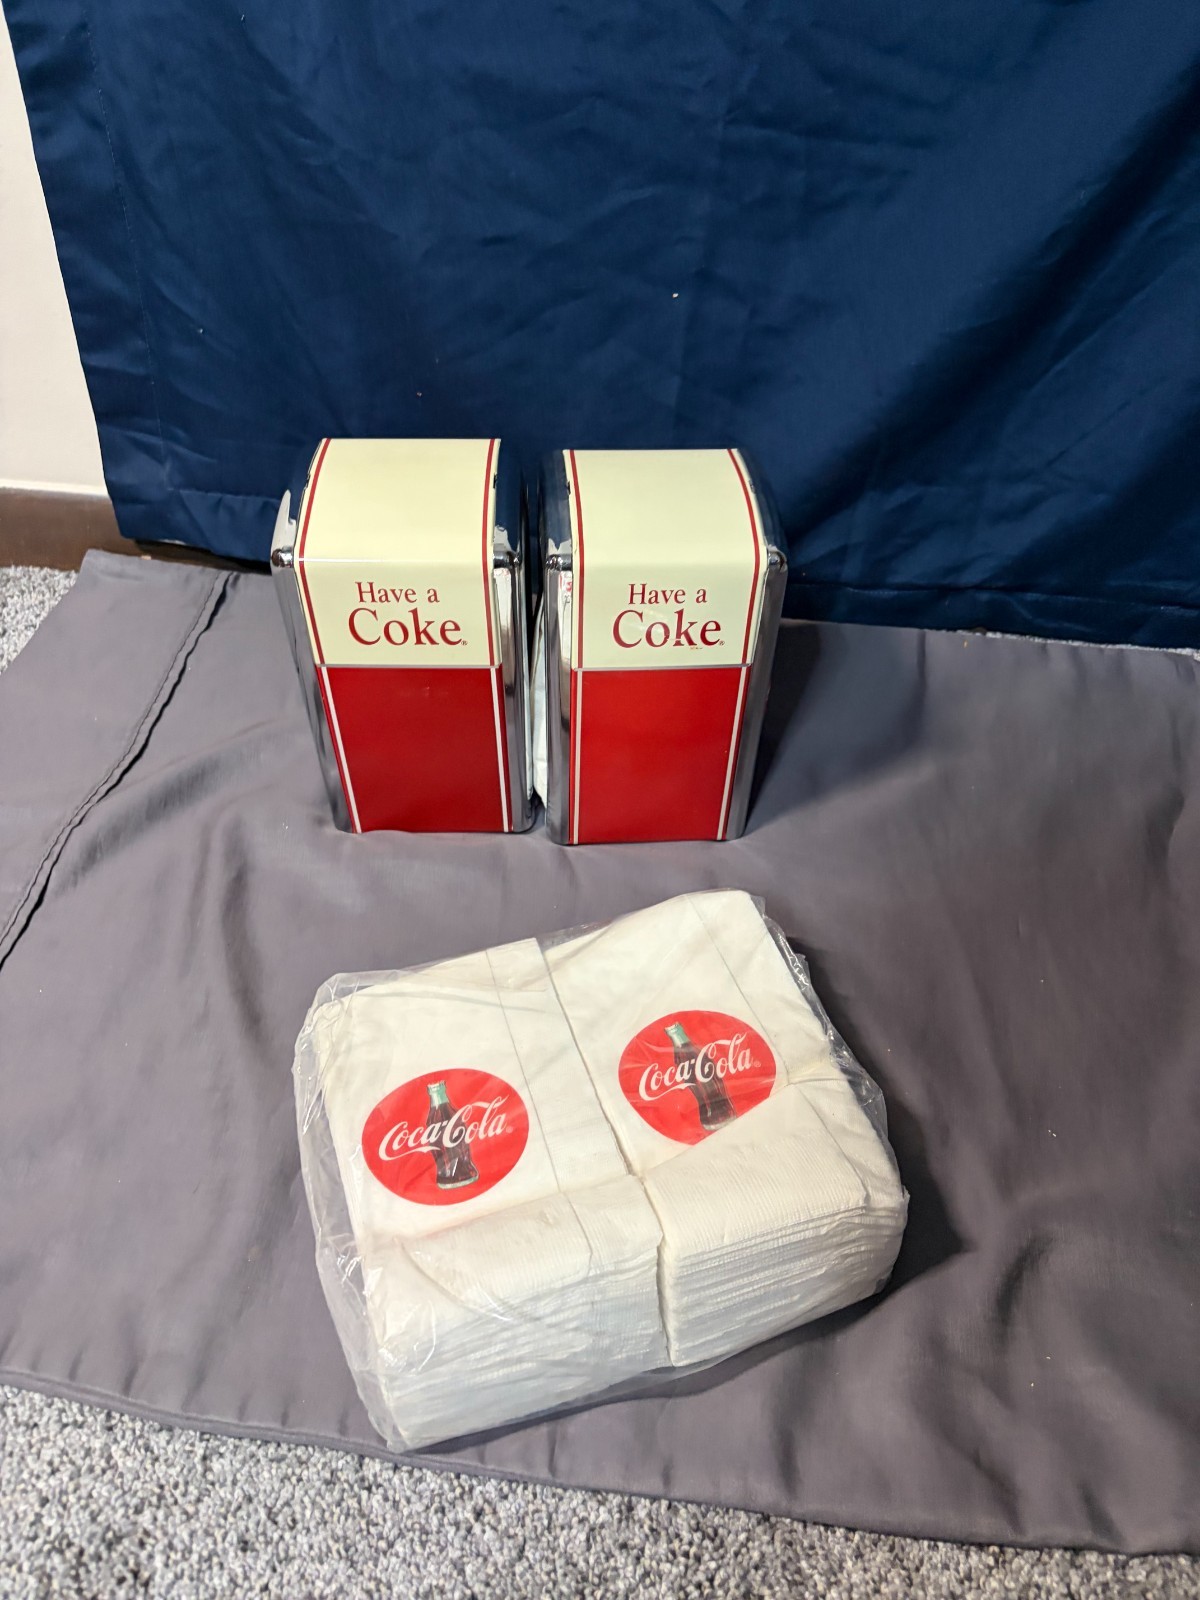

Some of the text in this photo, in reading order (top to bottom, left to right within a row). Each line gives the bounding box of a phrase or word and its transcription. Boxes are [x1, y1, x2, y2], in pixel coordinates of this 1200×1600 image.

[355, 581, 440, 603] Have a
[628, 582, 708, 605] Have a
[638, 1031, 752, 1102] Coca-Cola
[378, 1094, 510, 1161] Coca-Cola
